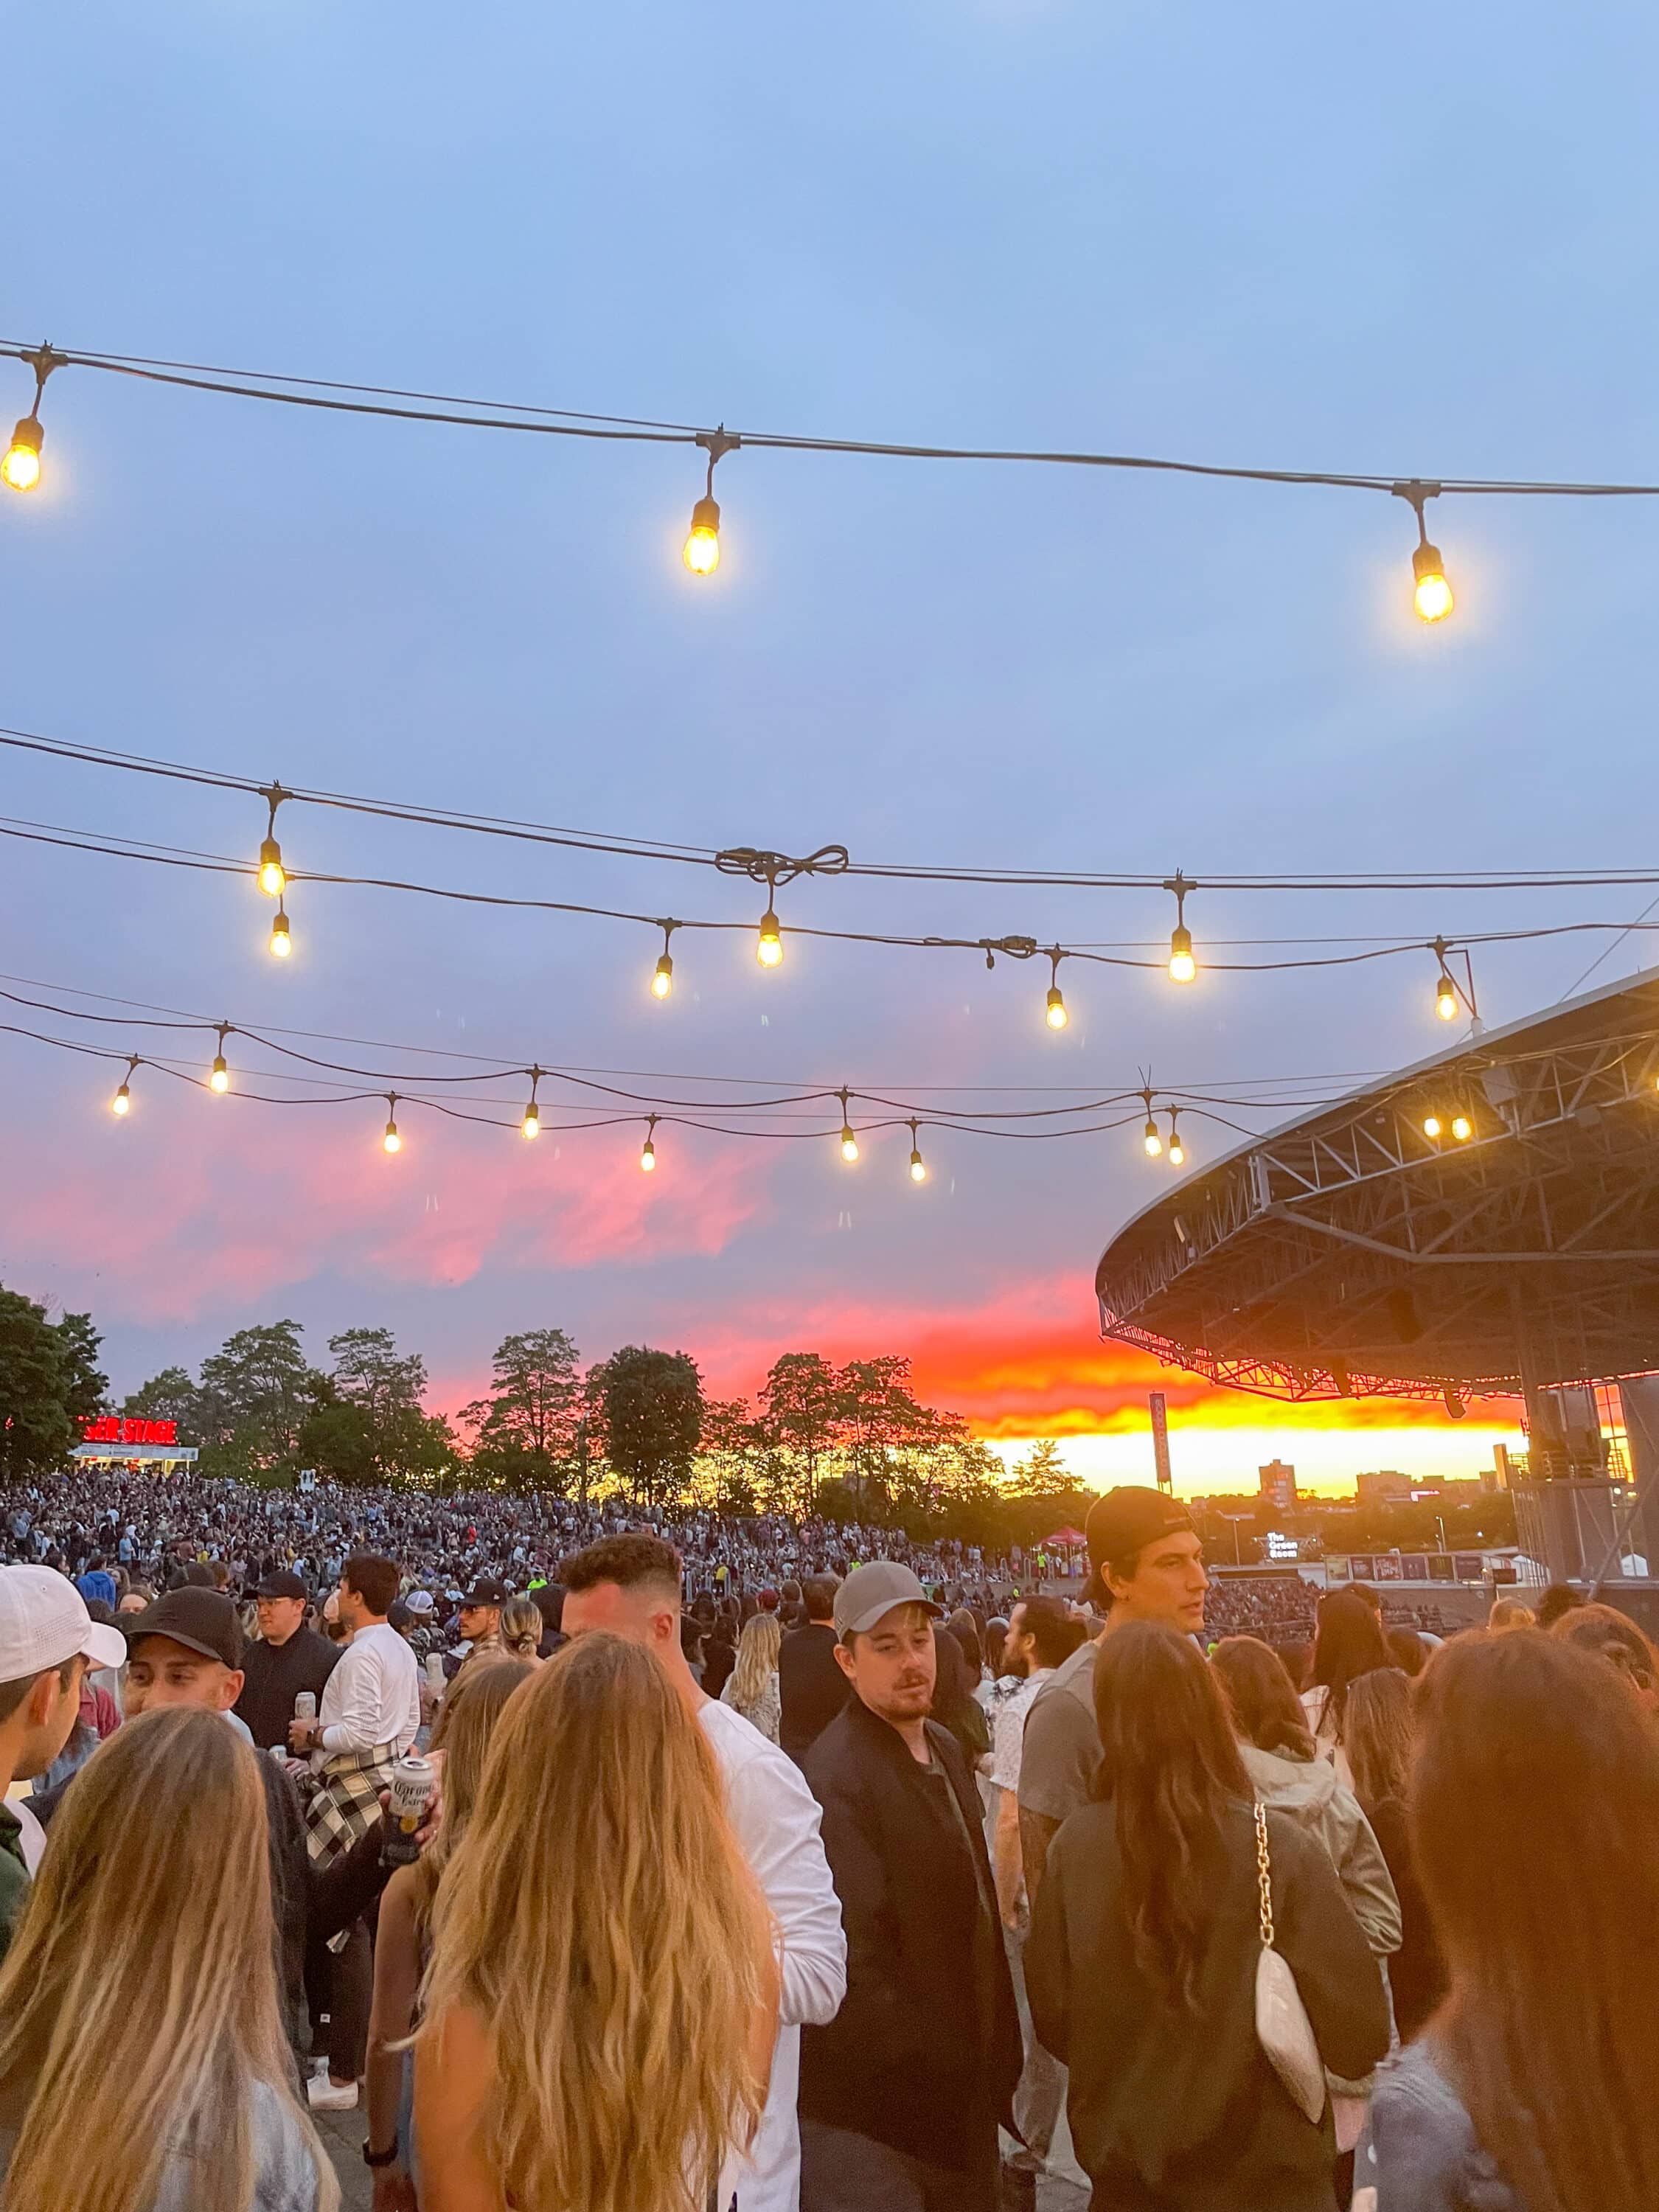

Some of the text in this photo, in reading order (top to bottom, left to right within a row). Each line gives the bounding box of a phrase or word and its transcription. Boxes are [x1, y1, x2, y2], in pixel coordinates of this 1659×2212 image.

[122, 1418, 178, 1444] STAGE
[1267, 1532, 1284, 1541] The
[1270, 1550, 1297, 1558] Room
